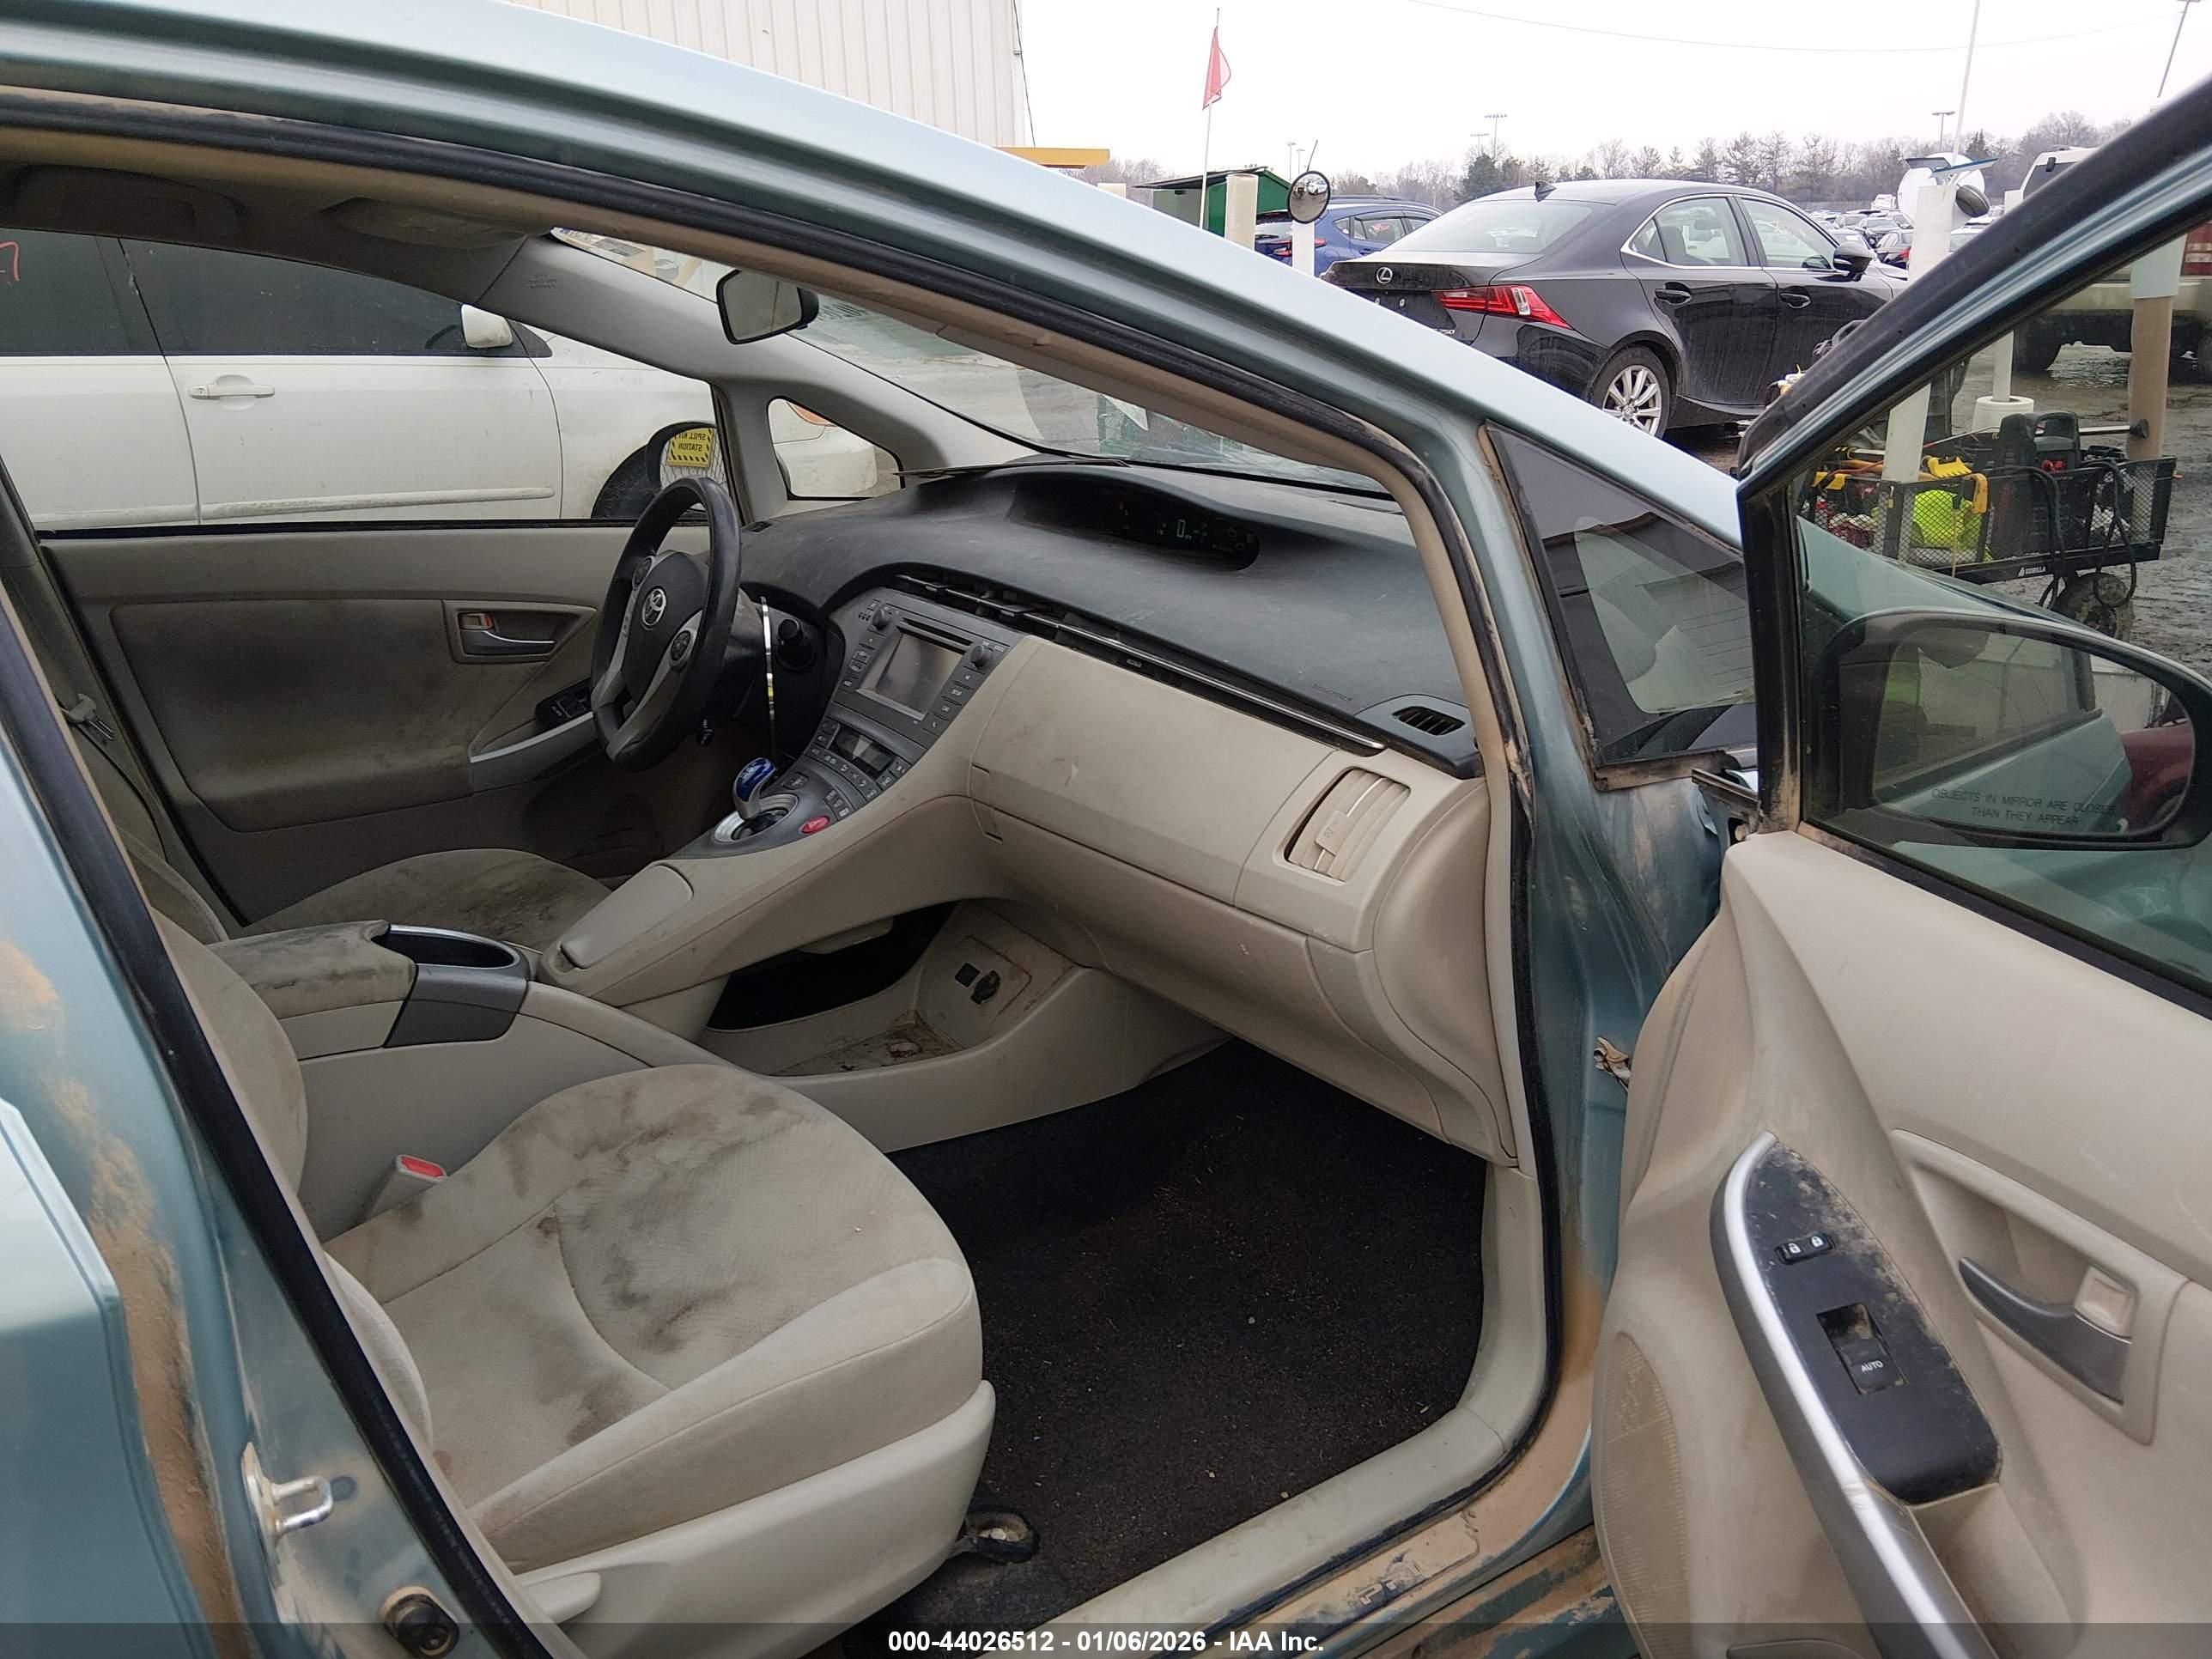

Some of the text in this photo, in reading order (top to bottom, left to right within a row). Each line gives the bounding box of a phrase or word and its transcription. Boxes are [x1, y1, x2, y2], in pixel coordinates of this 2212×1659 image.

[1932, 788, 2117, 815] OBJECTS IN MIRROR ARE CLOSER
[1972, 806, 2079, 824] THAN THEY APPEAR
[1861, 1359, 1884, 1372] AUTO
